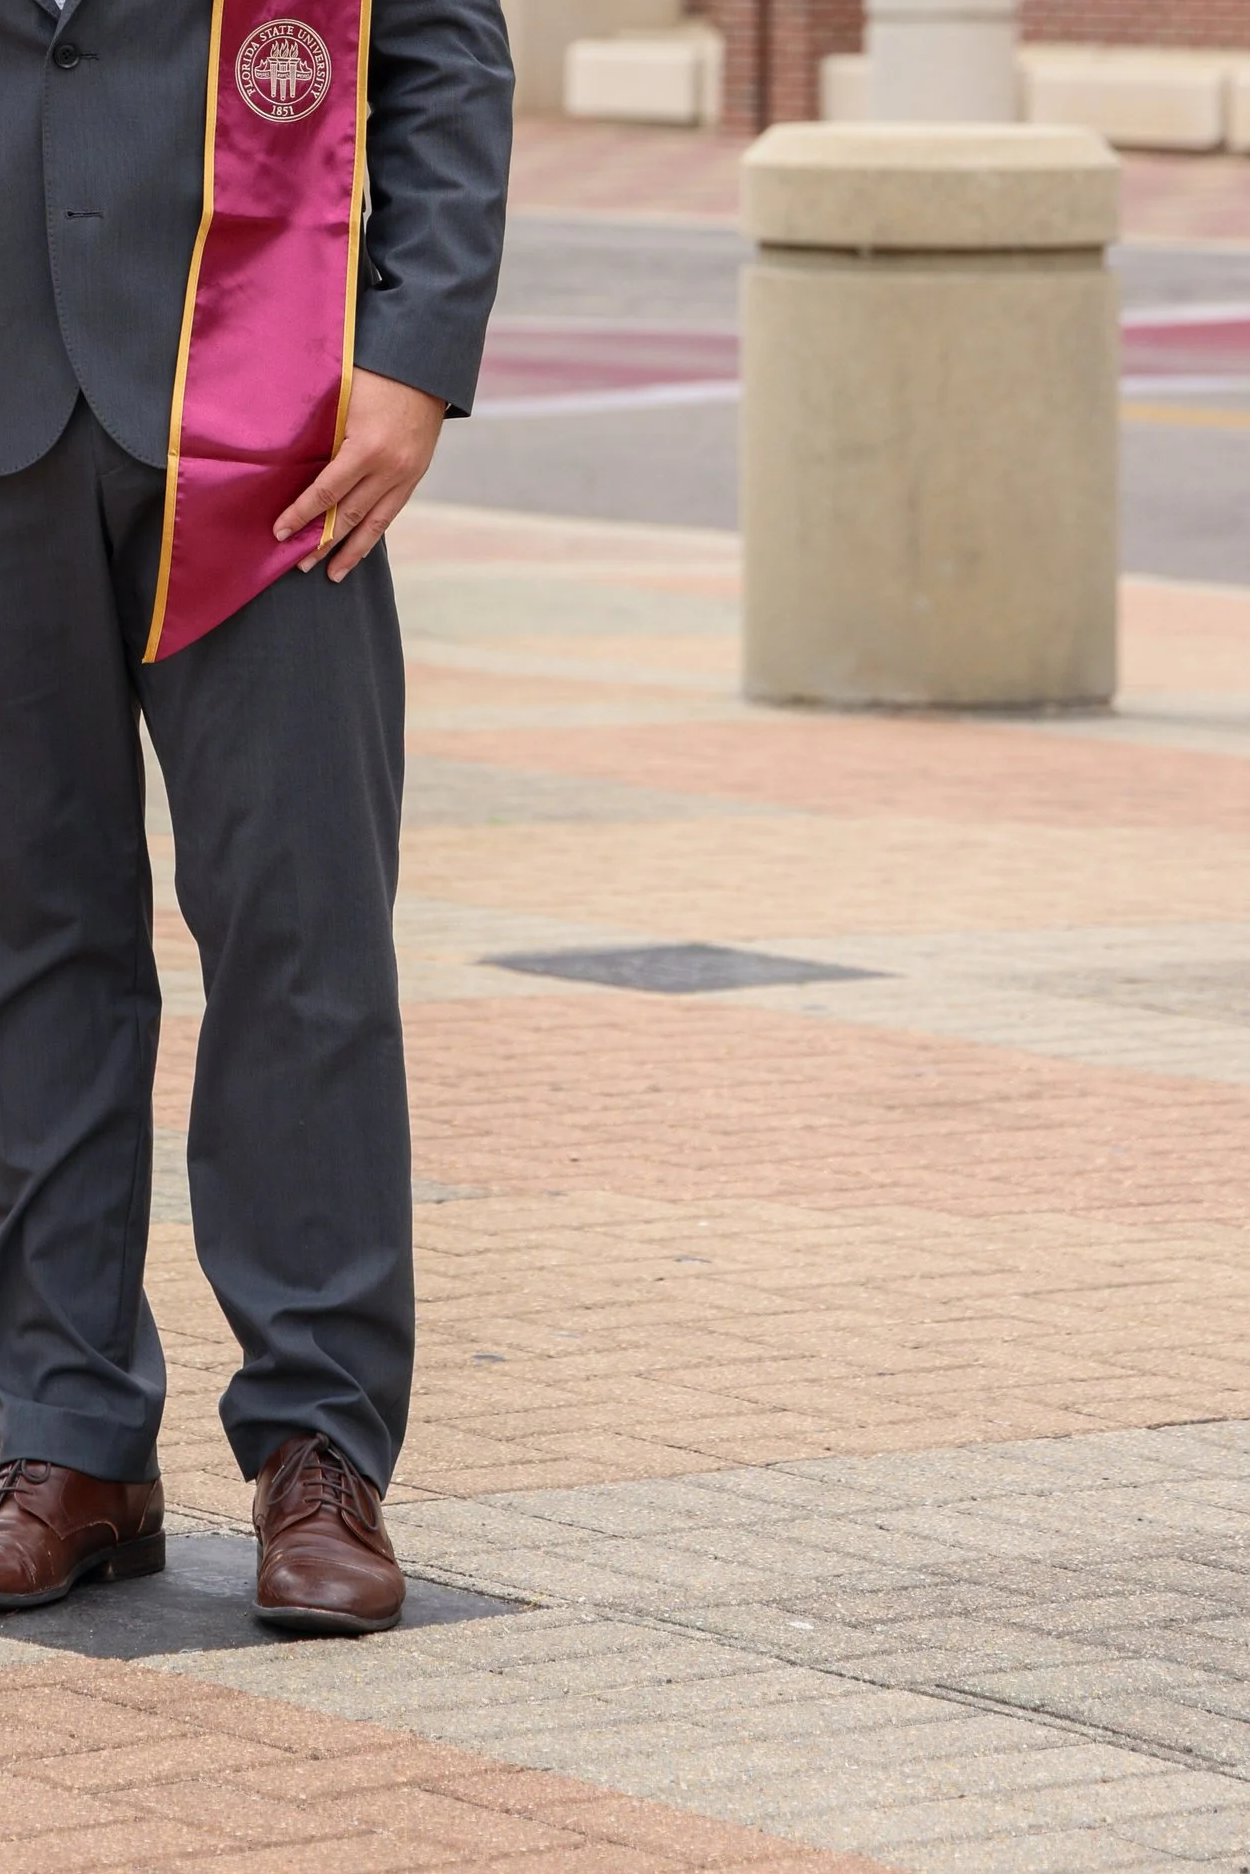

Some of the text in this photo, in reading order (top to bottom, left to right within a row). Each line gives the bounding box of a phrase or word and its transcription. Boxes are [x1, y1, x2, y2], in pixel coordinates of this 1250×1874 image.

[241, 25, 326, 99] FLORIDA STATE UNIVERSITY
[271, 105, 295, 116] 1851
